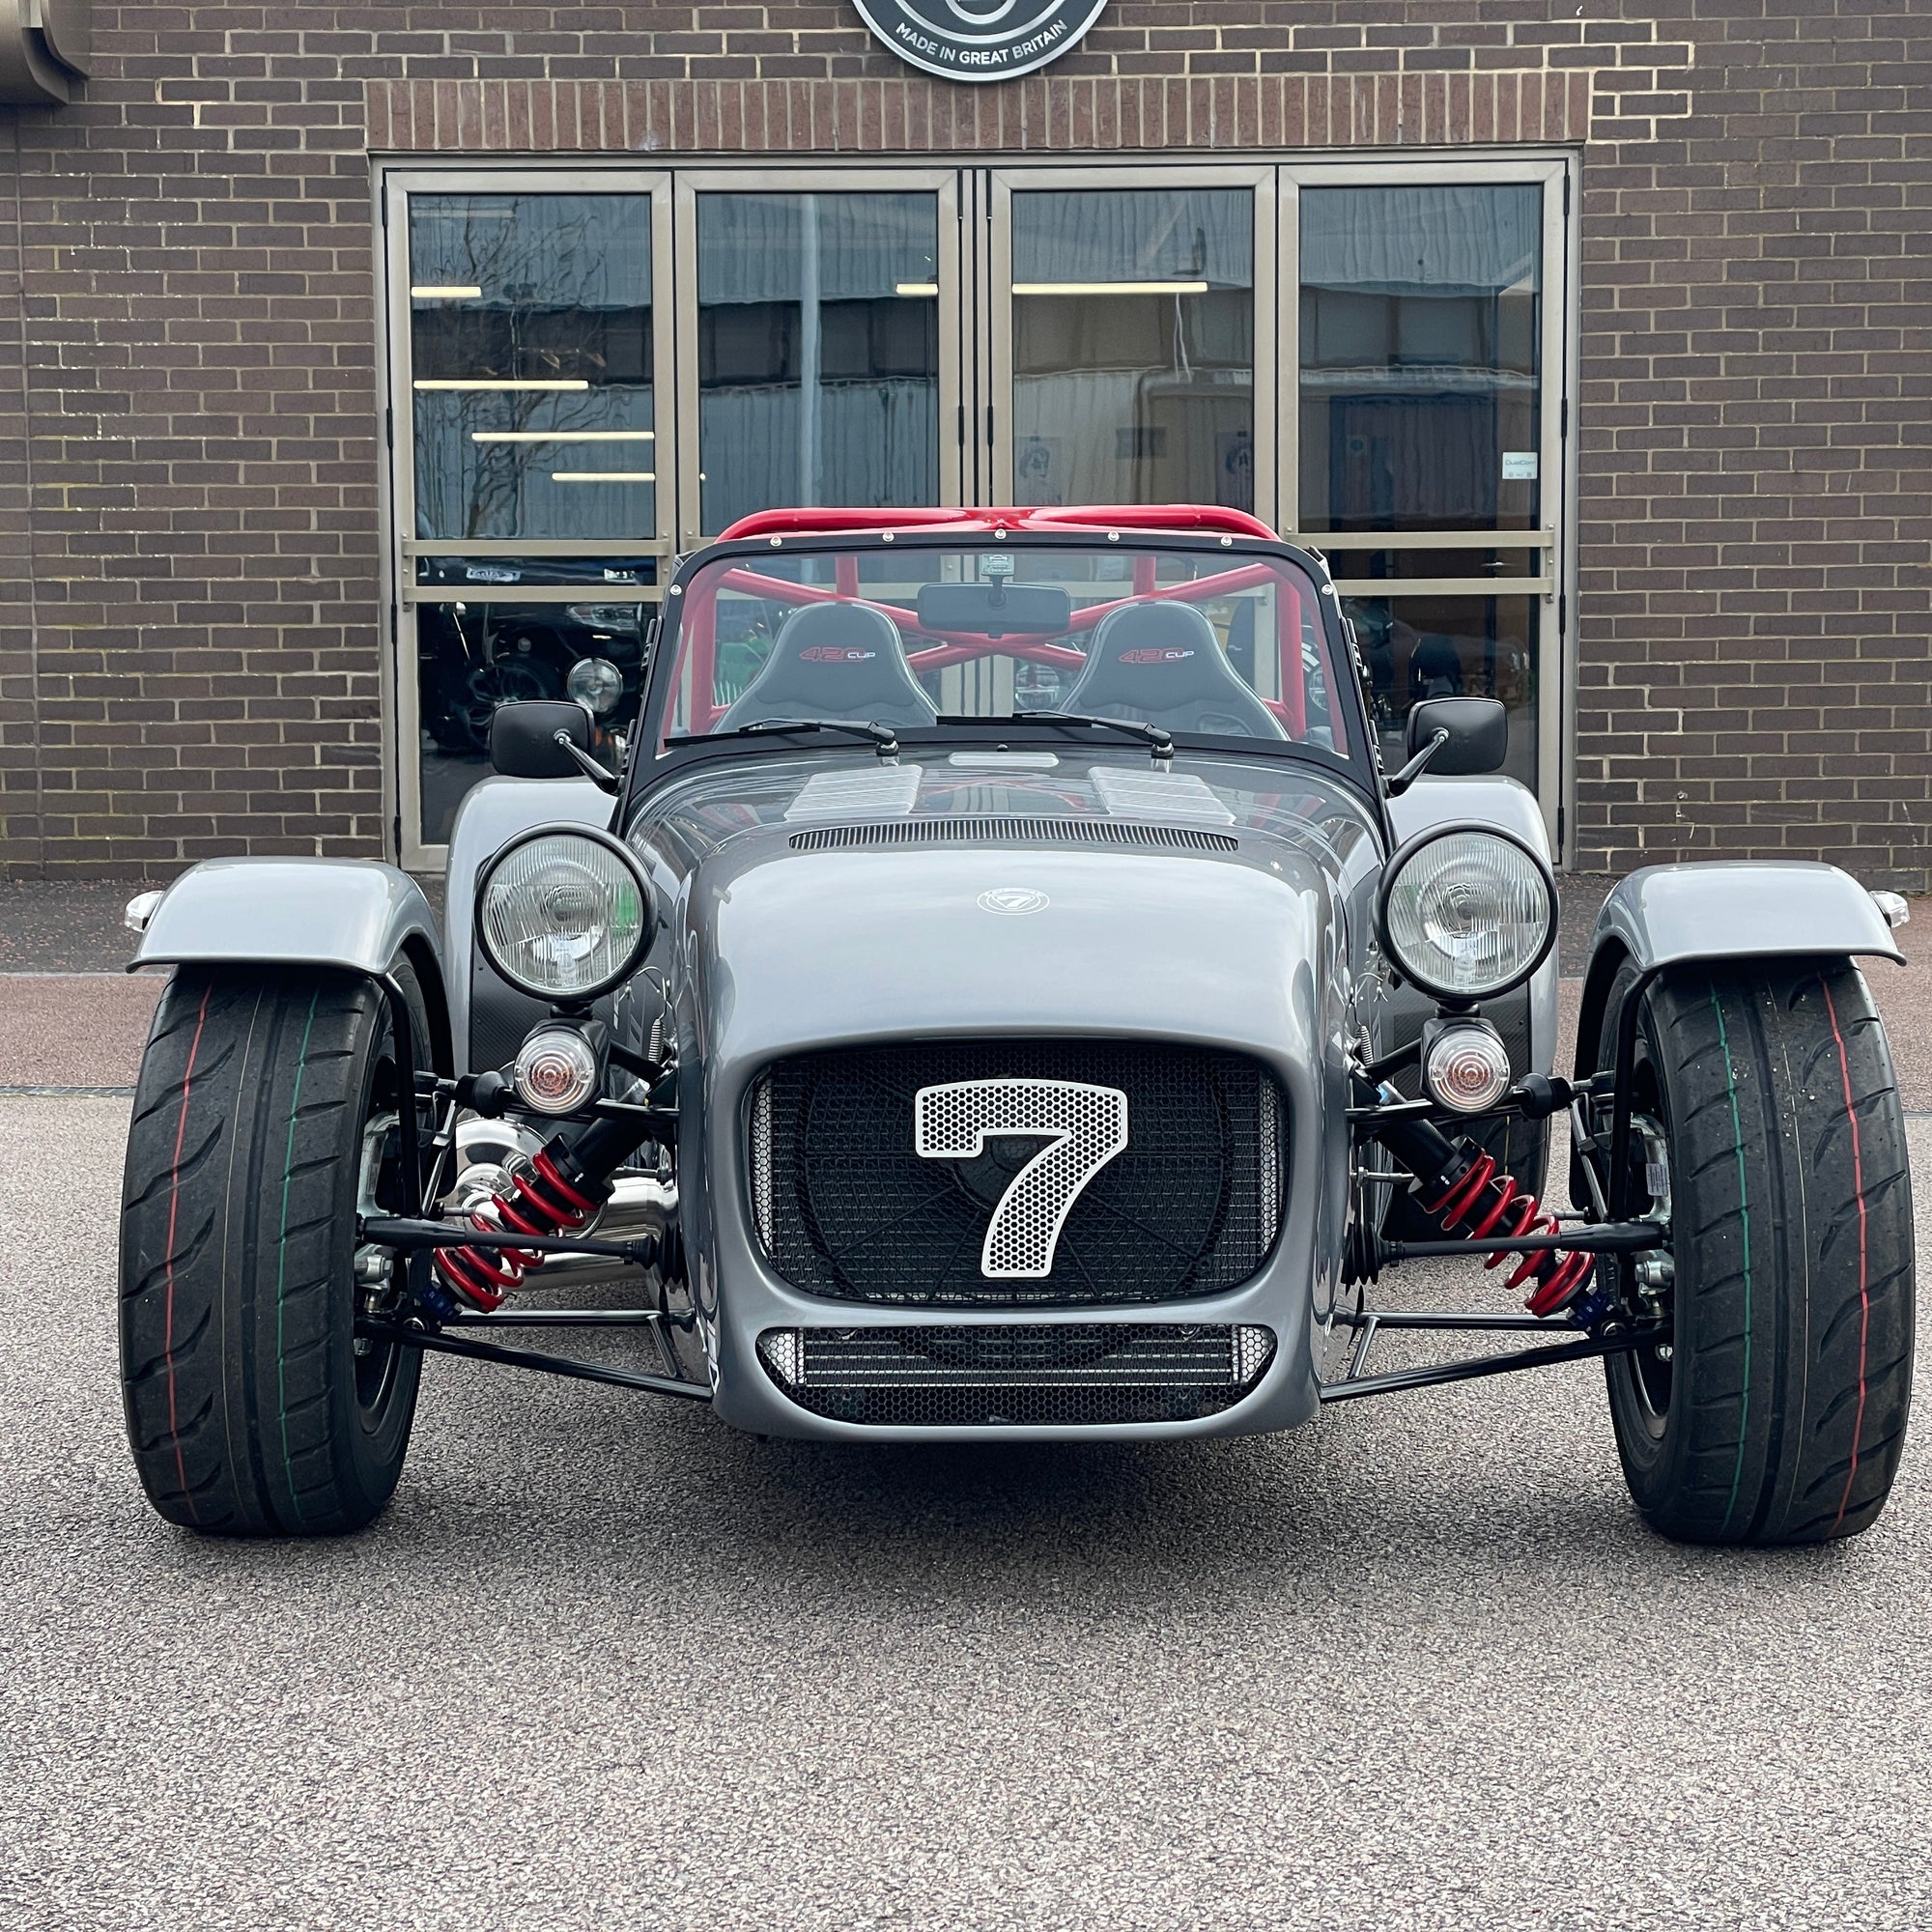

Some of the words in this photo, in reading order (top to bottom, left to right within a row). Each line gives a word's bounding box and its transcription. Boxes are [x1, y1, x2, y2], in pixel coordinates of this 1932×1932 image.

[895, 22, 938, 55] MADE
[939, 46, 956, 62] IN
[959, 49, 1009, 65] GREAT
[1012, 19, 1067, 59] BRITAIN
[1165, 650, 1195, 659] CUP
[996, 895, 1032, 907] 7
[915, 1078, 1128, 1278] 7
